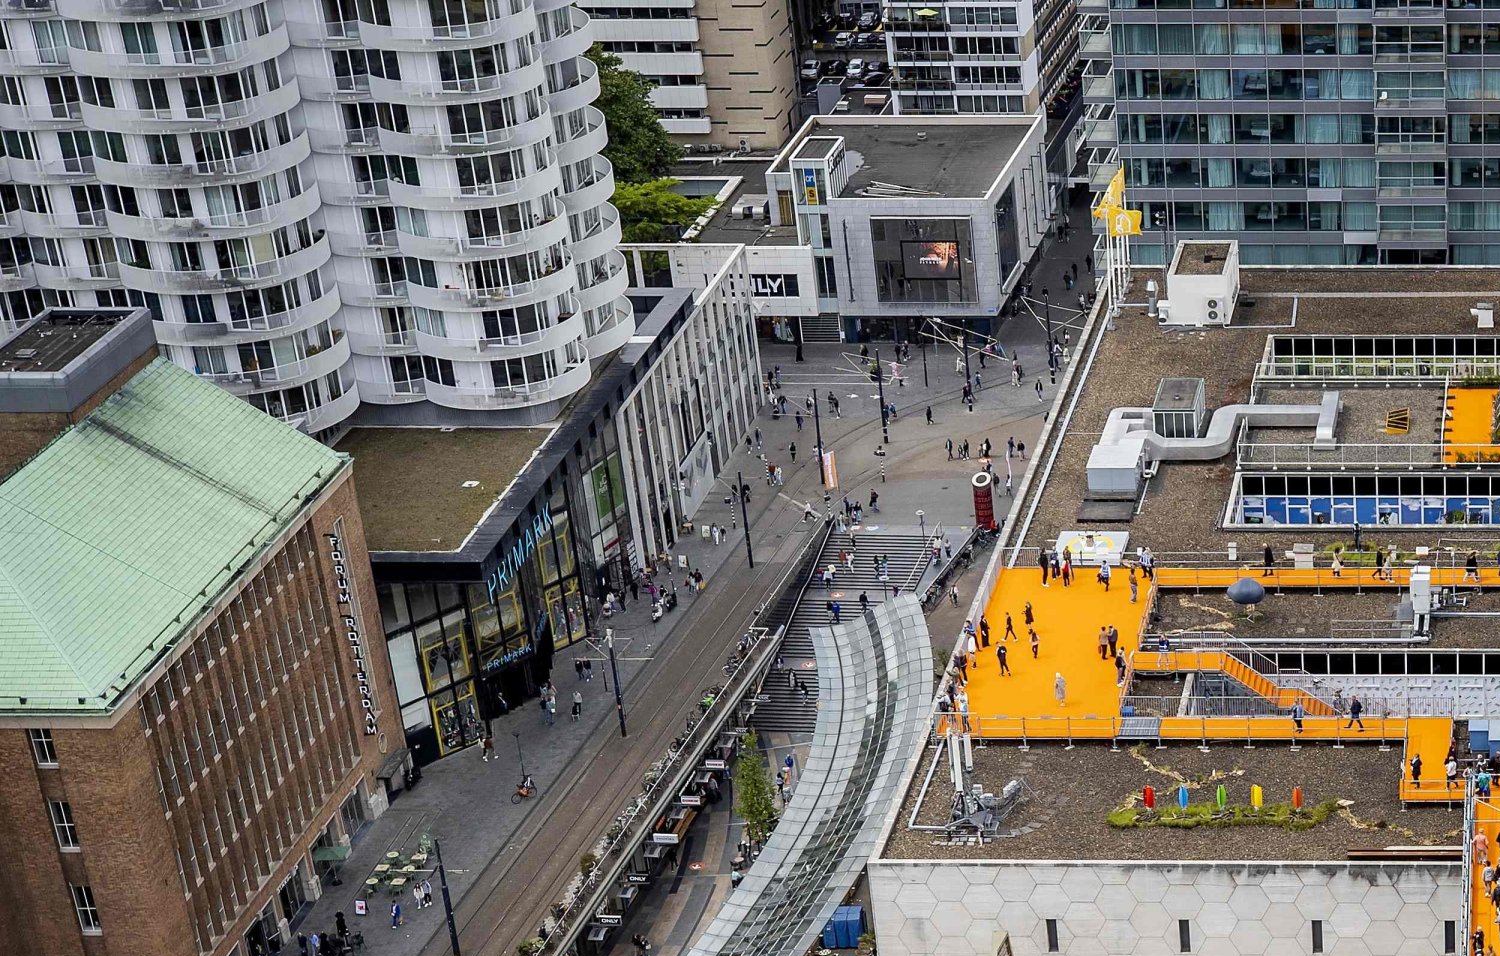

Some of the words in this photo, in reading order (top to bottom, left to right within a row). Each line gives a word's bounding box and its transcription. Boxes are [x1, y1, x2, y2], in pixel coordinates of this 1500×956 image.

[329, 537, 351, 603] FORUM
[487, 502, 554, 605] PRIMARK
[345, 618, 377, 735] ROTTERDAM
[486, 643, 533, 673] PRIMARK
